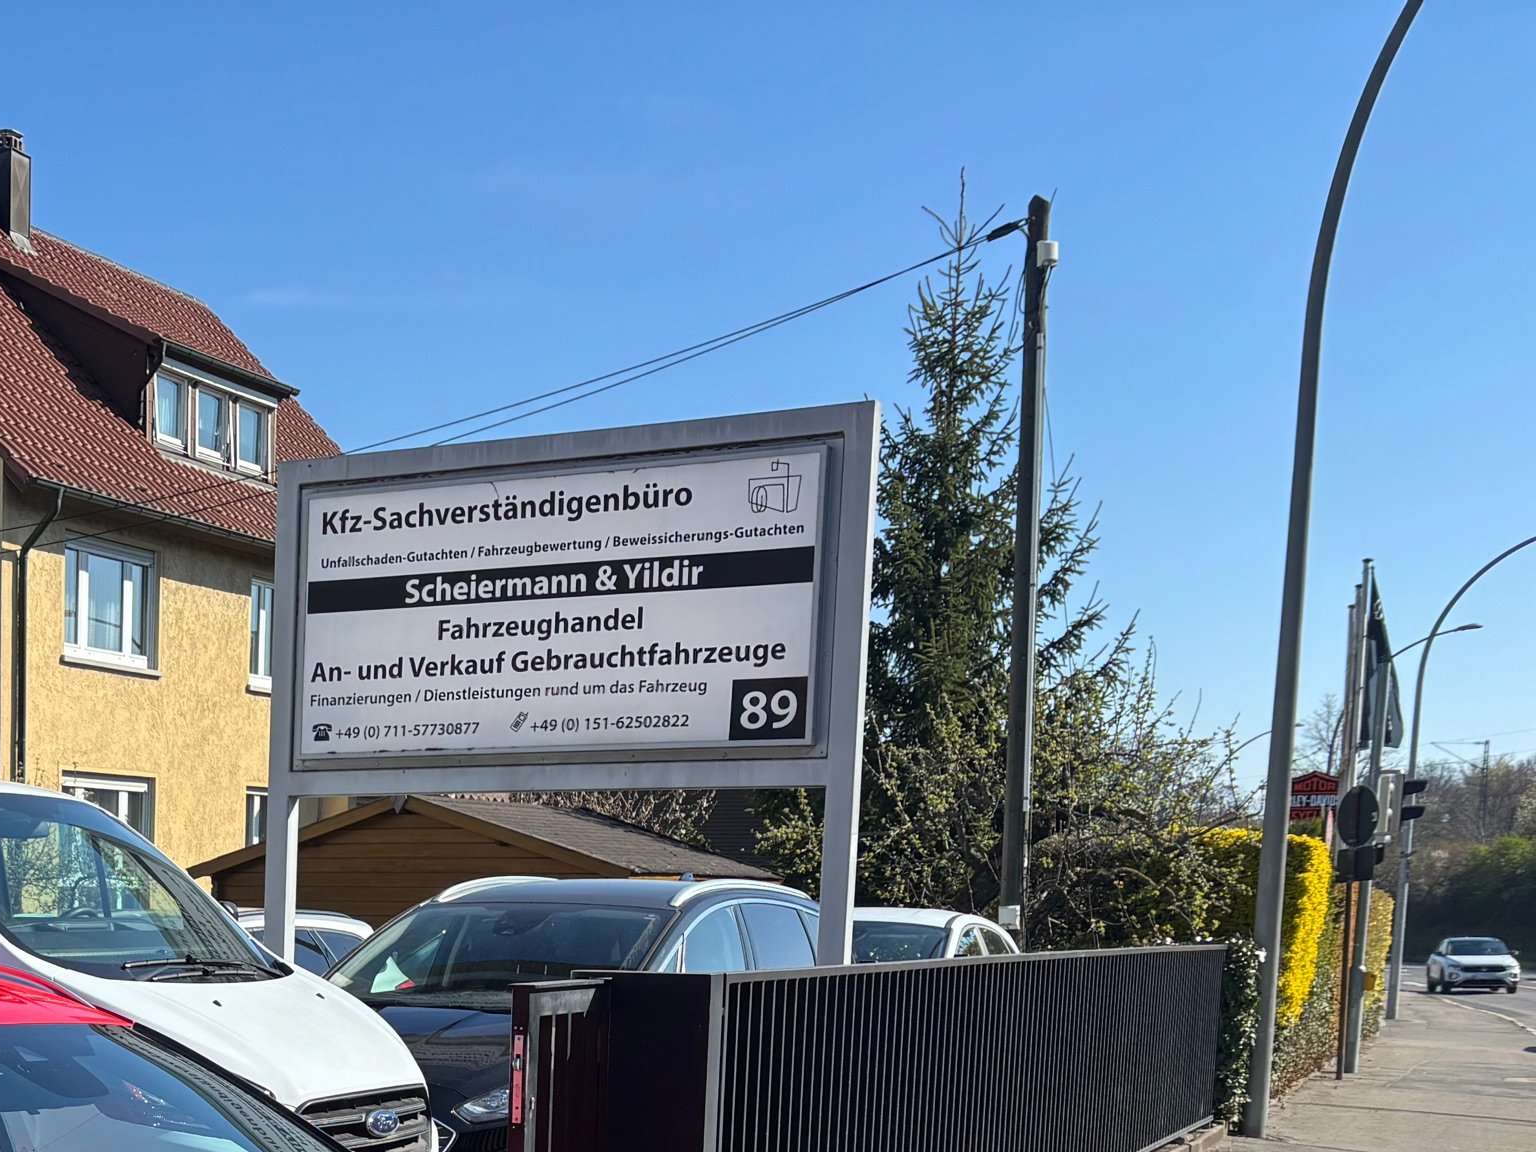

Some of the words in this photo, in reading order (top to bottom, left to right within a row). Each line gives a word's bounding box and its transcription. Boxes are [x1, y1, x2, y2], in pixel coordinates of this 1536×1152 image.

[321, 482, 693, 535] Kfz-Sachverständigenbüro
[320, 547, 468, 569] Unfallschaden-Gutachten
[478, 539, 602, 557] Fahrzeugbewertung
[613, 523, 805, 547] Beweissicherungs-Gutachten
[405, 573, 587, 604] Scheiermann
[595, 565, 617, 591] &
[623, 559, 704, 589] Yildir
[437, 606, 644, 641] Fahrzeughandel
[311, 662, 351, 682] An-
[358, 657, 403, 680] und
[409, 651, 506, 677] Verkauf
[511, 642, 786, 673] Gebrauchtfahrzeuge
[310, 692, 412, 707] Finanzierungen
[424, 686, 541, 702] Dienstleistungen
[545, 682, 579, 696] rund
[583, 685, 605, 695] um
[610, 680, 634, 694] das
[639, 679, 708, 695] Fahrzeug
[739, 689, 798, 730] 89
[335, 727, 360, 740] +49
[363, 725, 380, 740] (0)
[384, 721, 480, 737] 711-57730877
[530, 718, 558, 732] +49
[561, 717, 580, 732] (0)
[585, 714, 690, 730] 151-62502822
